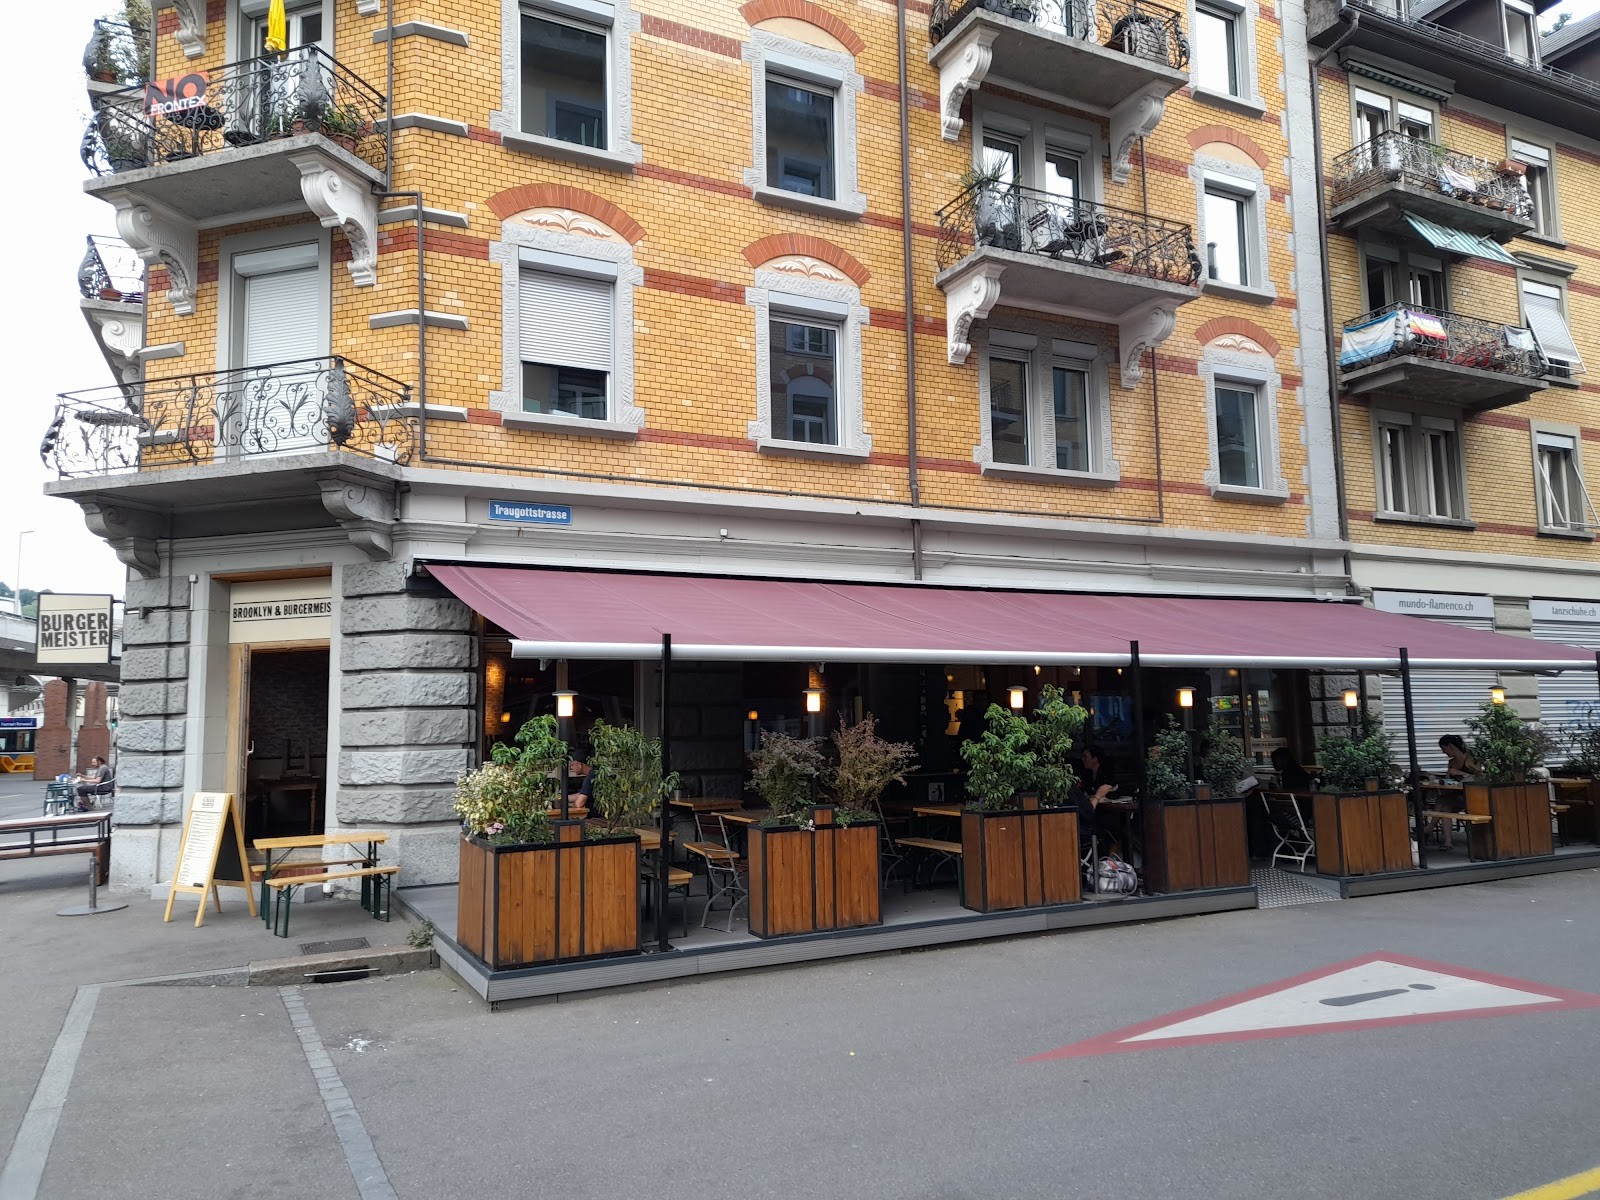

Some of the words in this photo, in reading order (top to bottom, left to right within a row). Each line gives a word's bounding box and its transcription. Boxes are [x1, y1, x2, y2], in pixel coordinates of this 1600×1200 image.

[145, 74, 206, 114] NO
[150, 95, 207, 115] FRONTEX
[494, 504, 567, 519] Traugottstrasse
[233, 606, 272, 618] BROOKLYN
[274, 605, 281, 616] &
[283, 602, 332, 615] BURGERMEIS
[1398, 598, 1474, 611] mundo-flamenco.ch
[1551, 606, 1597, 616] tanzschuhe.ch
[41, 613, 108, 632] BURGER
[41, 630, 109, 648] MEISTER
